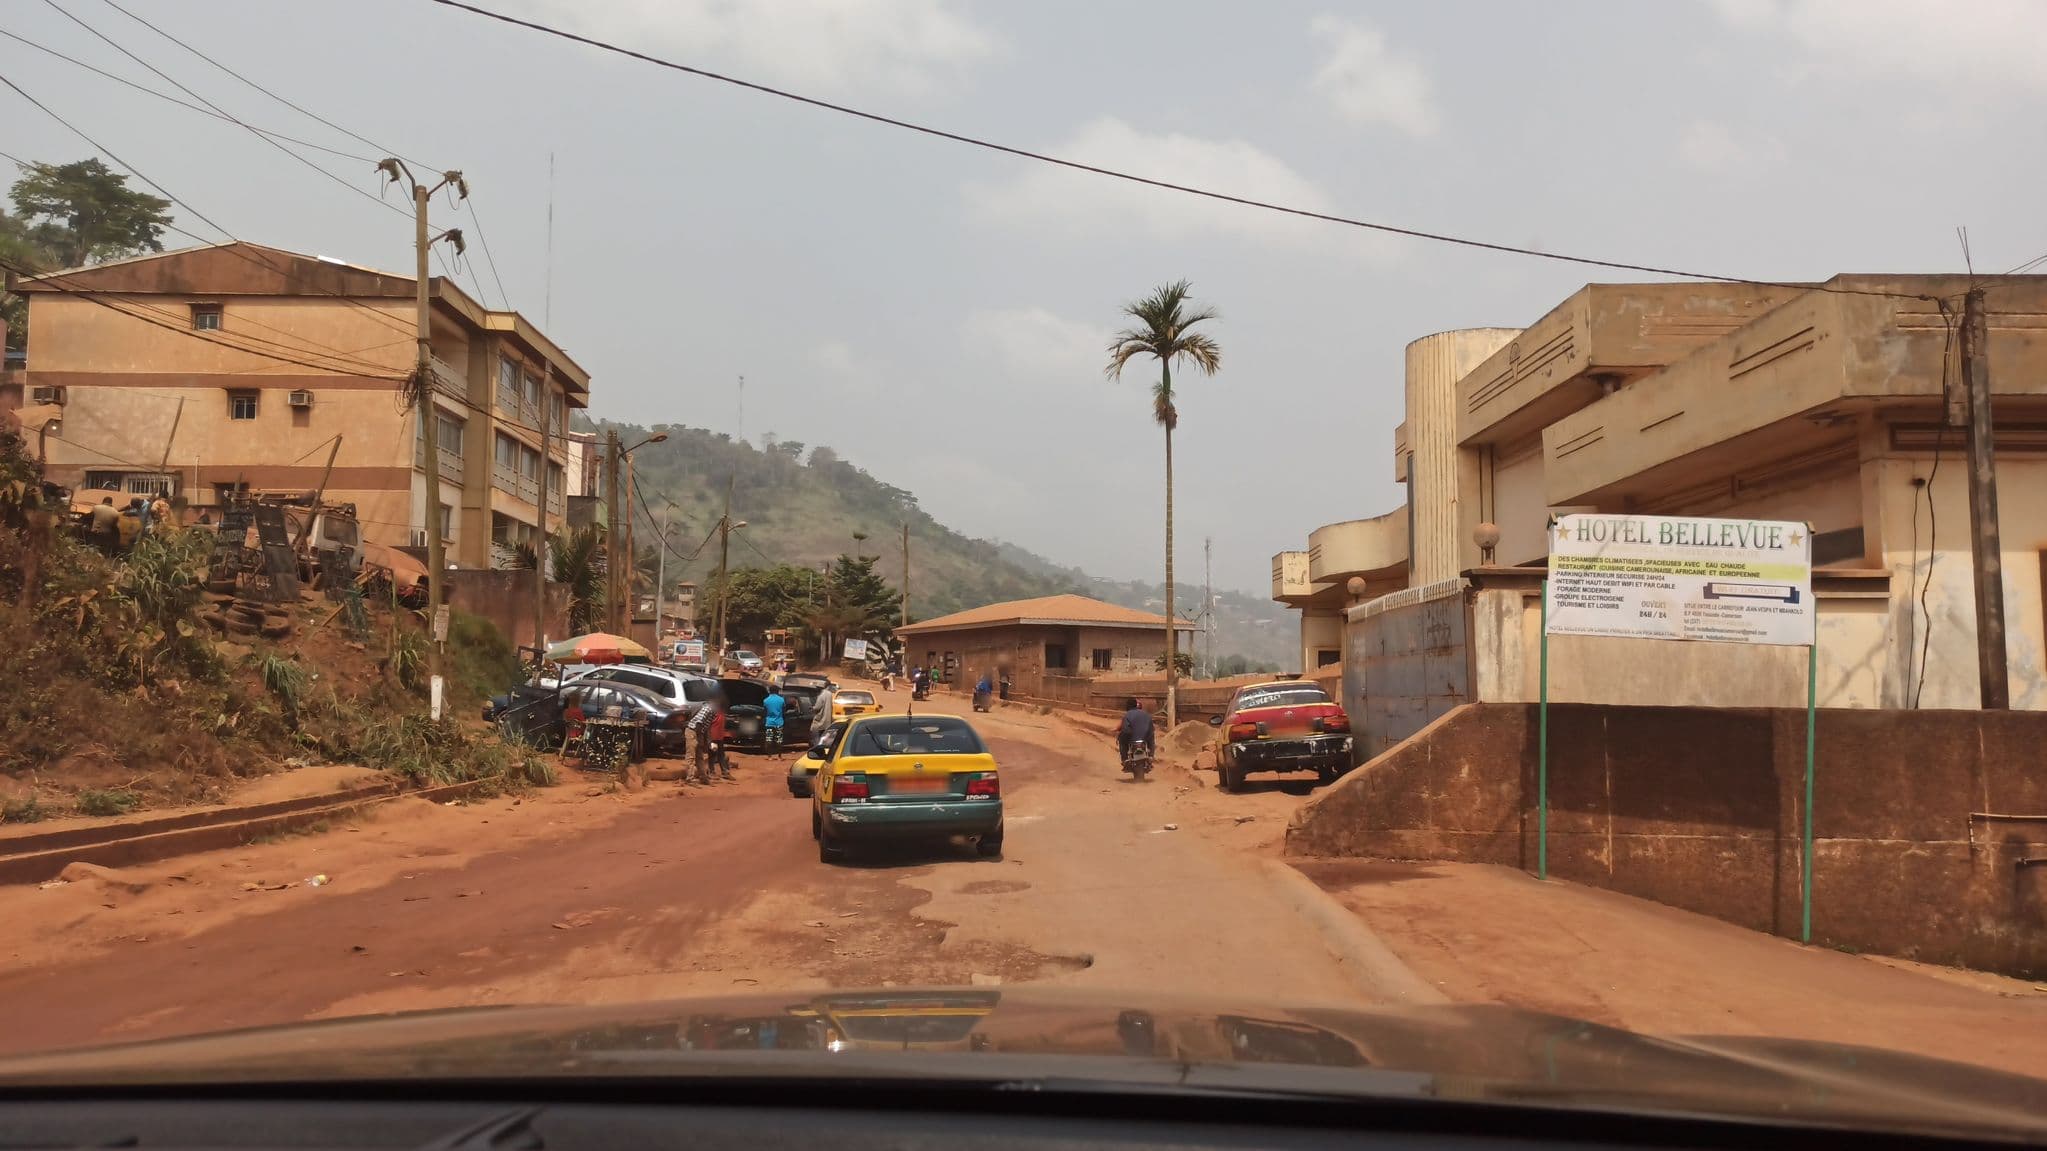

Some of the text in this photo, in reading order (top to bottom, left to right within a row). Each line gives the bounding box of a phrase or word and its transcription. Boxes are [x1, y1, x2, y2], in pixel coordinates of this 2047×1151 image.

[1576, 519, 1783, 550] HOTEL BELLEVUE
[1604, 557, 1642, 565] CLIMATISEES
[1719, 570, 1760, 578] EUROPEENNE
